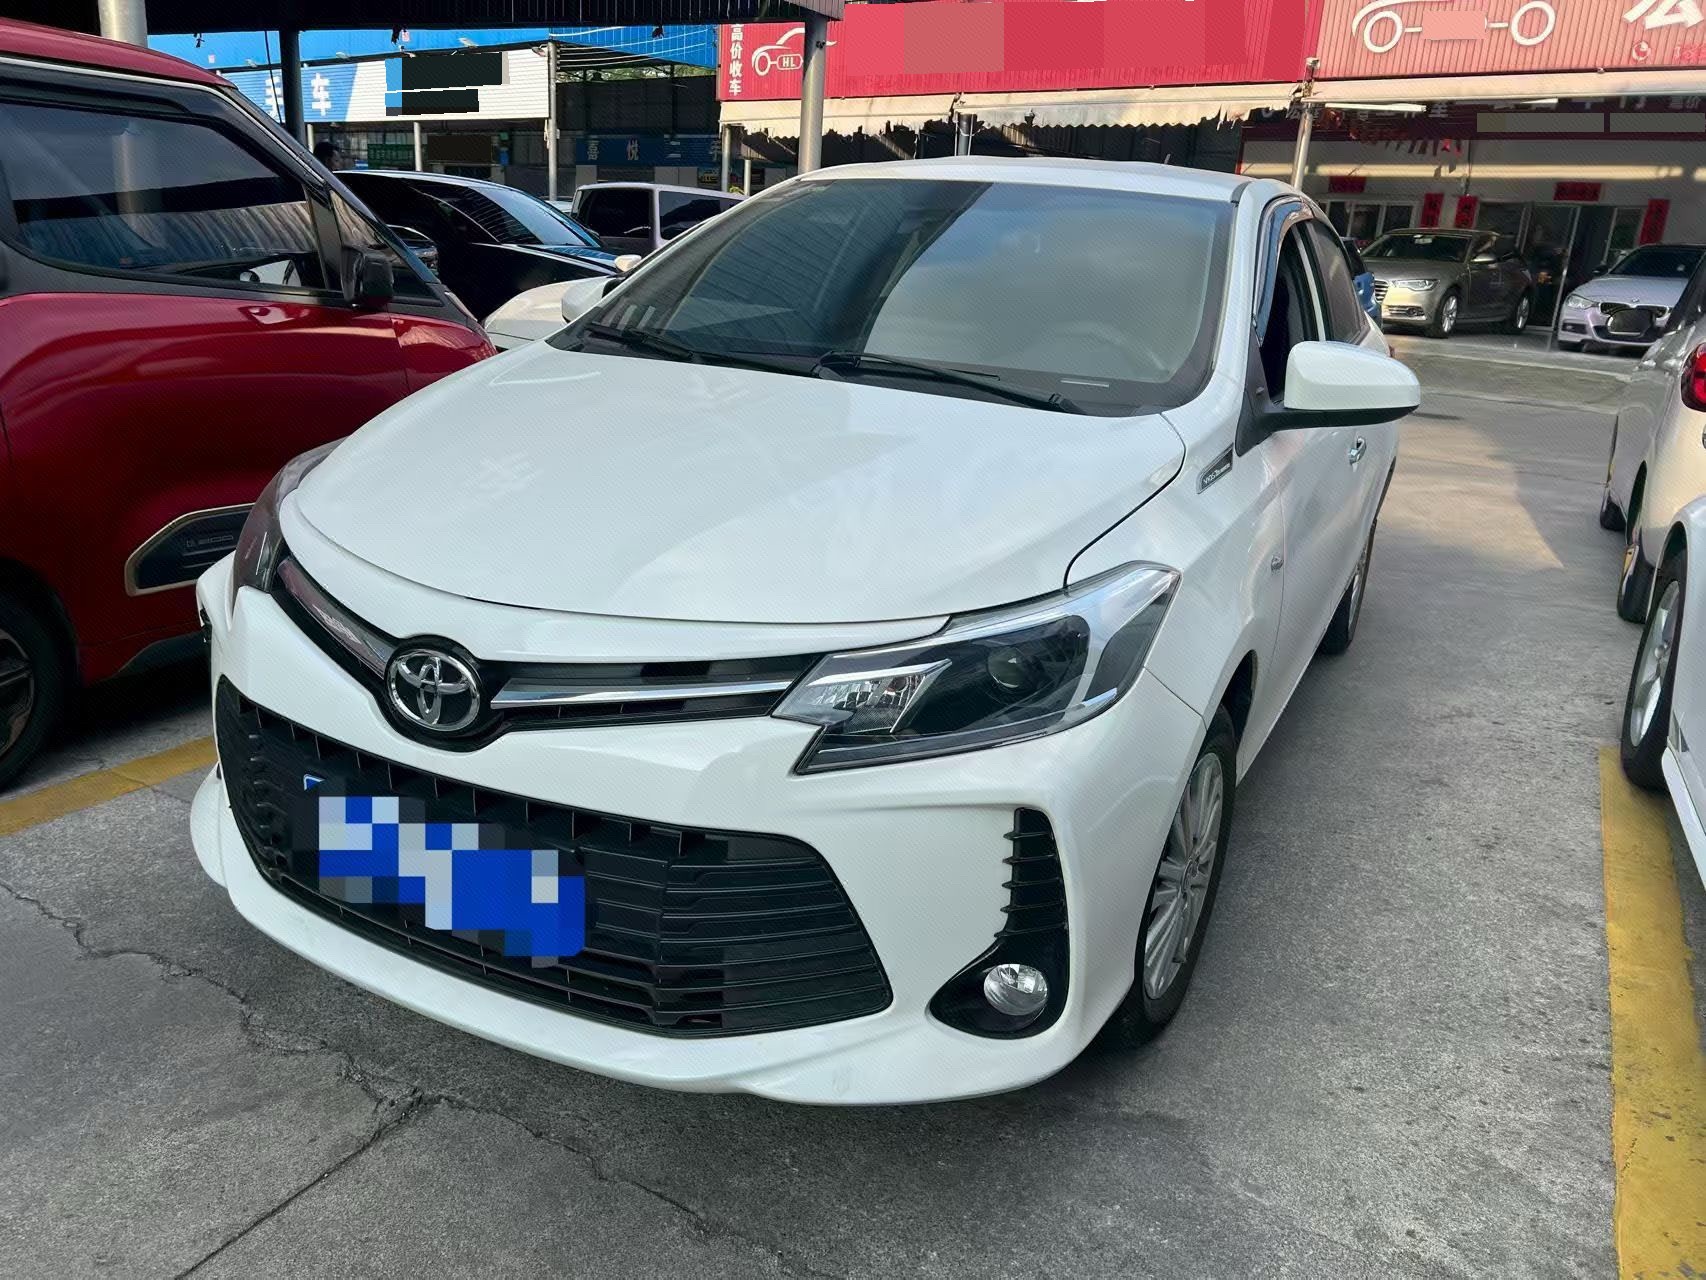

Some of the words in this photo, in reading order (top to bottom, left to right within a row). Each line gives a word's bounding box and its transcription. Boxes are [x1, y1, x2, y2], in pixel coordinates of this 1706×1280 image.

[729, 24, 744, 96] 高价收车
[782, 56, 797, 68] HL
